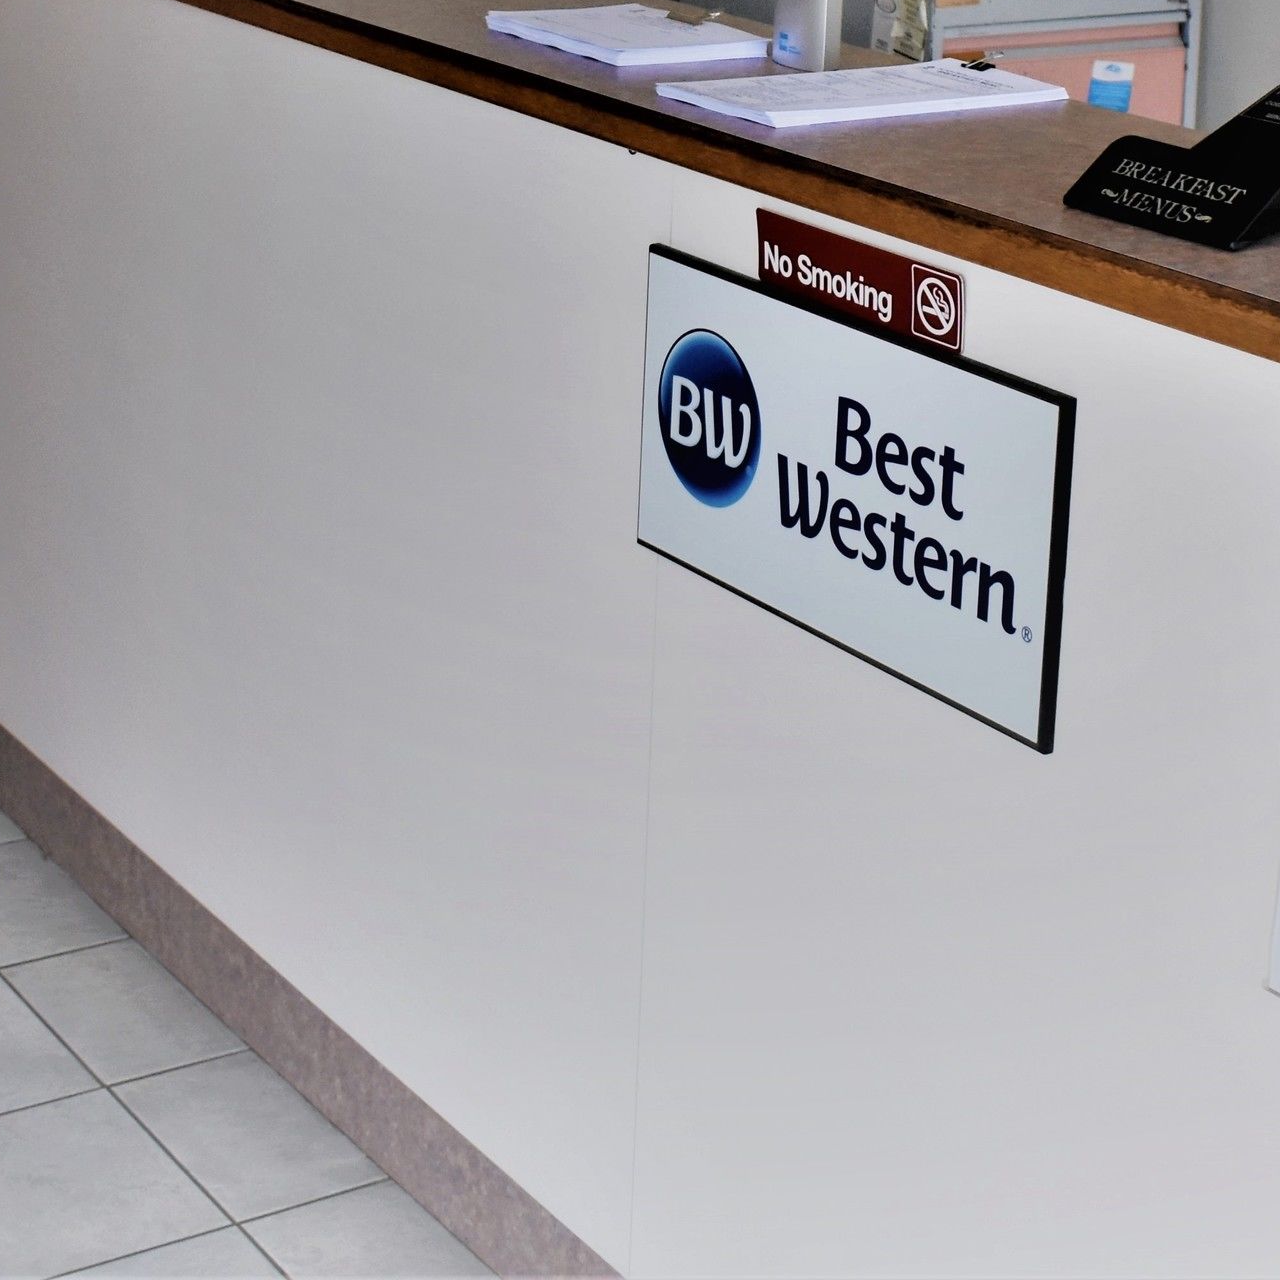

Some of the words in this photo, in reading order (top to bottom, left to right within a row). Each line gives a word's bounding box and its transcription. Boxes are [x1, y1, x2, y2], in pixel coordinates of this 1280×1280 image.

[1112, 158, 1247, 206] BREAKFAST
[1113, 188, 1197, 224] MENUS
[763, 240, 792, 280] No
[796, 254, 893, 323] Smoking
[668, 374, 752, 468] BW
[834, 396, 966, 521] Best
[776, 451, 1018, 635] Western
